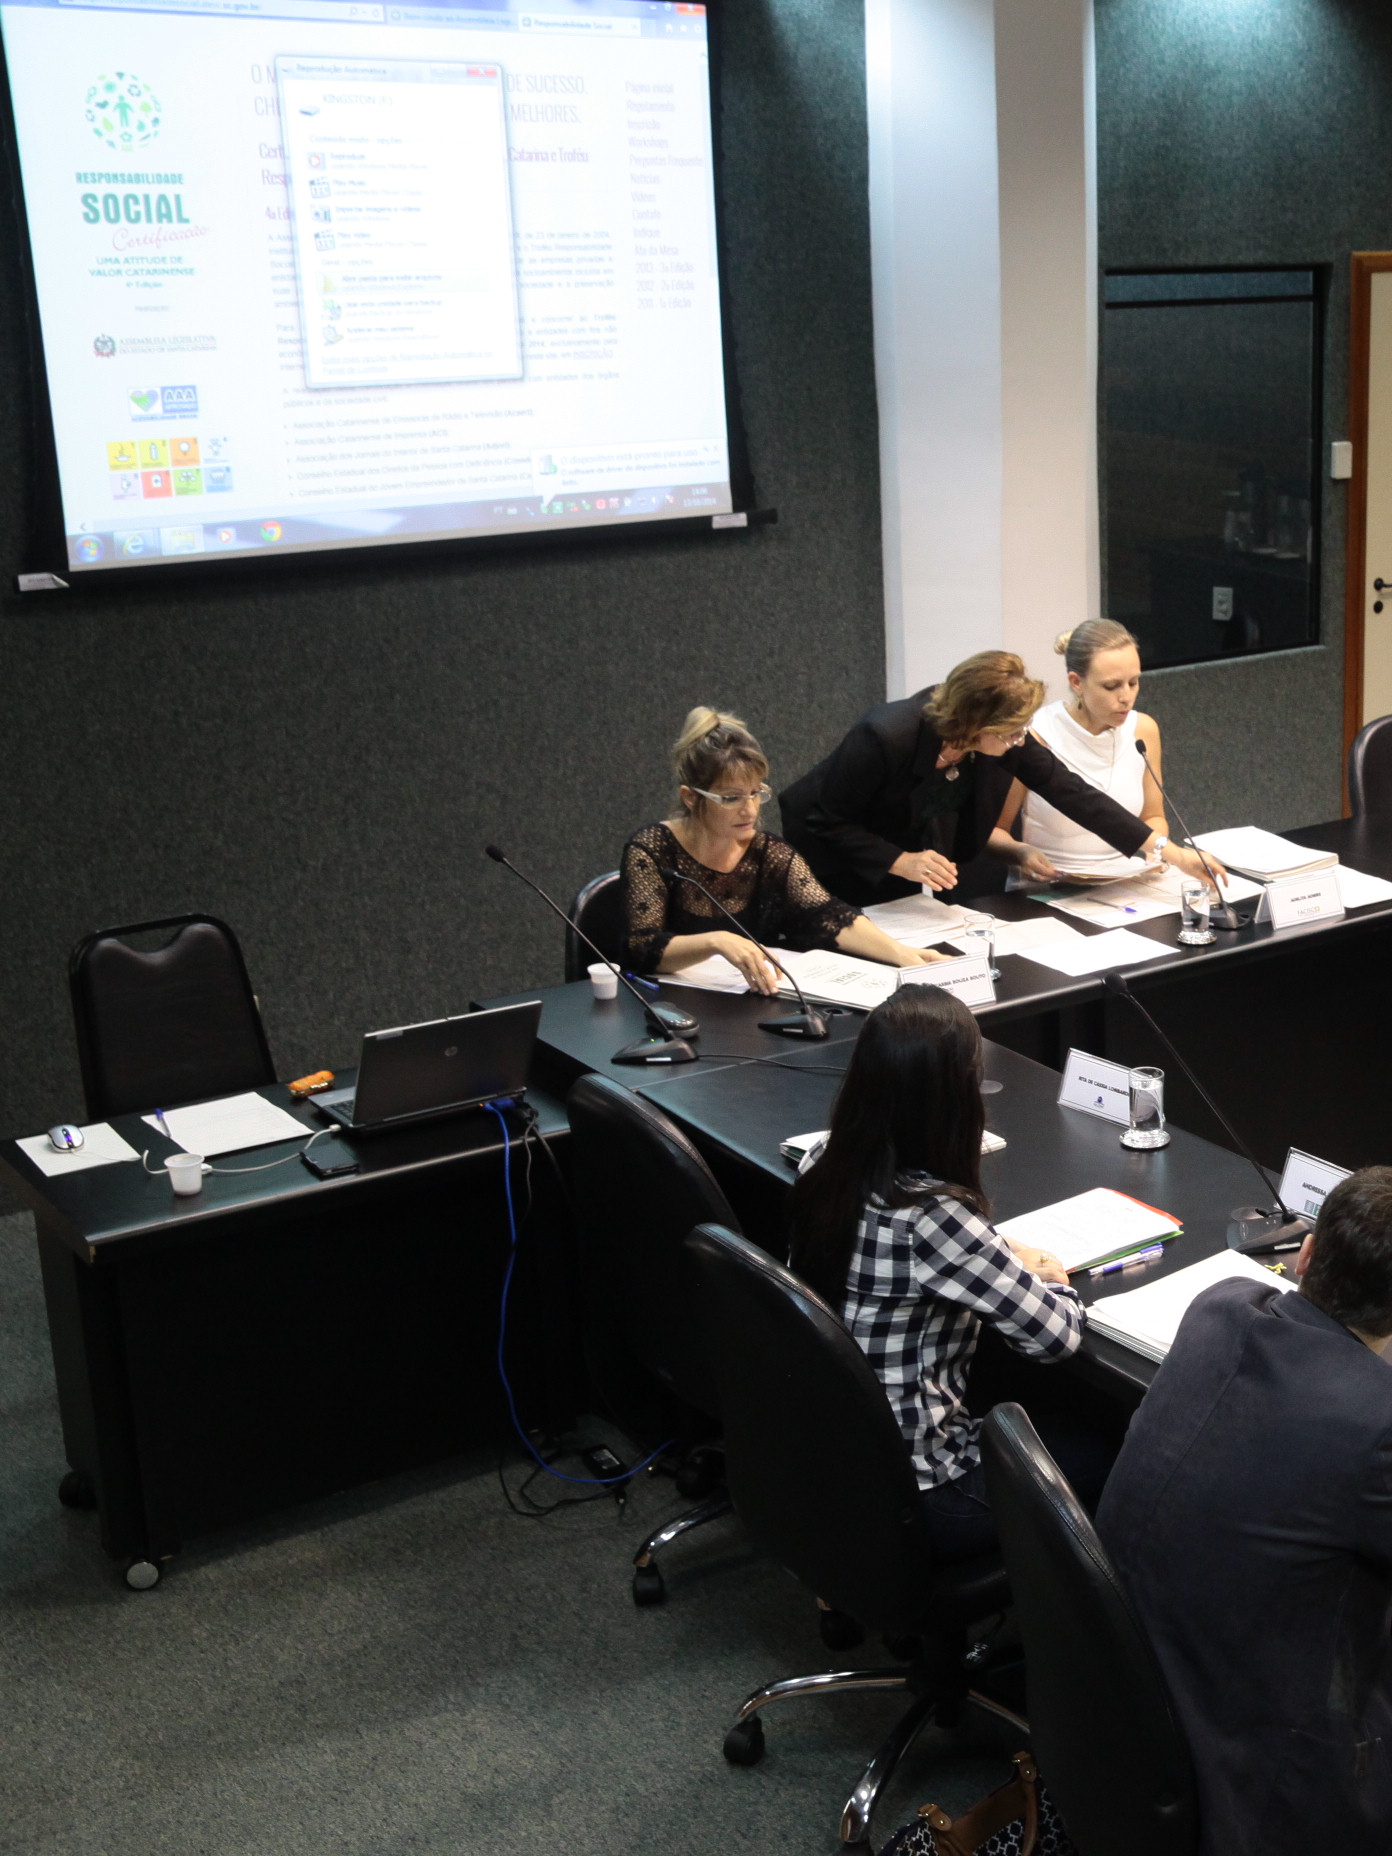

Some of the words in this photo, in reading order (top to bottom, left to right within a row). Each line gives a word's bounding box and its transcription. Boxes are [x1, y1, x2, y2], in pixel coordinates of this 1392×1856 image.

[75, 172, 184, 184] RESPONSABILIDADE
[81, 192, 192, 224] SOCIAL
[96, 256, 120, 264] UMA
[123, 256, 168, 264] ATITUDE
[170, 256, 184, 264] DE
[88, 268, 122, 276] VALOR
[125, 267, 196, 276] CATARINENSE
[1302, 1182, 1327, 1196] ANDRESSA
